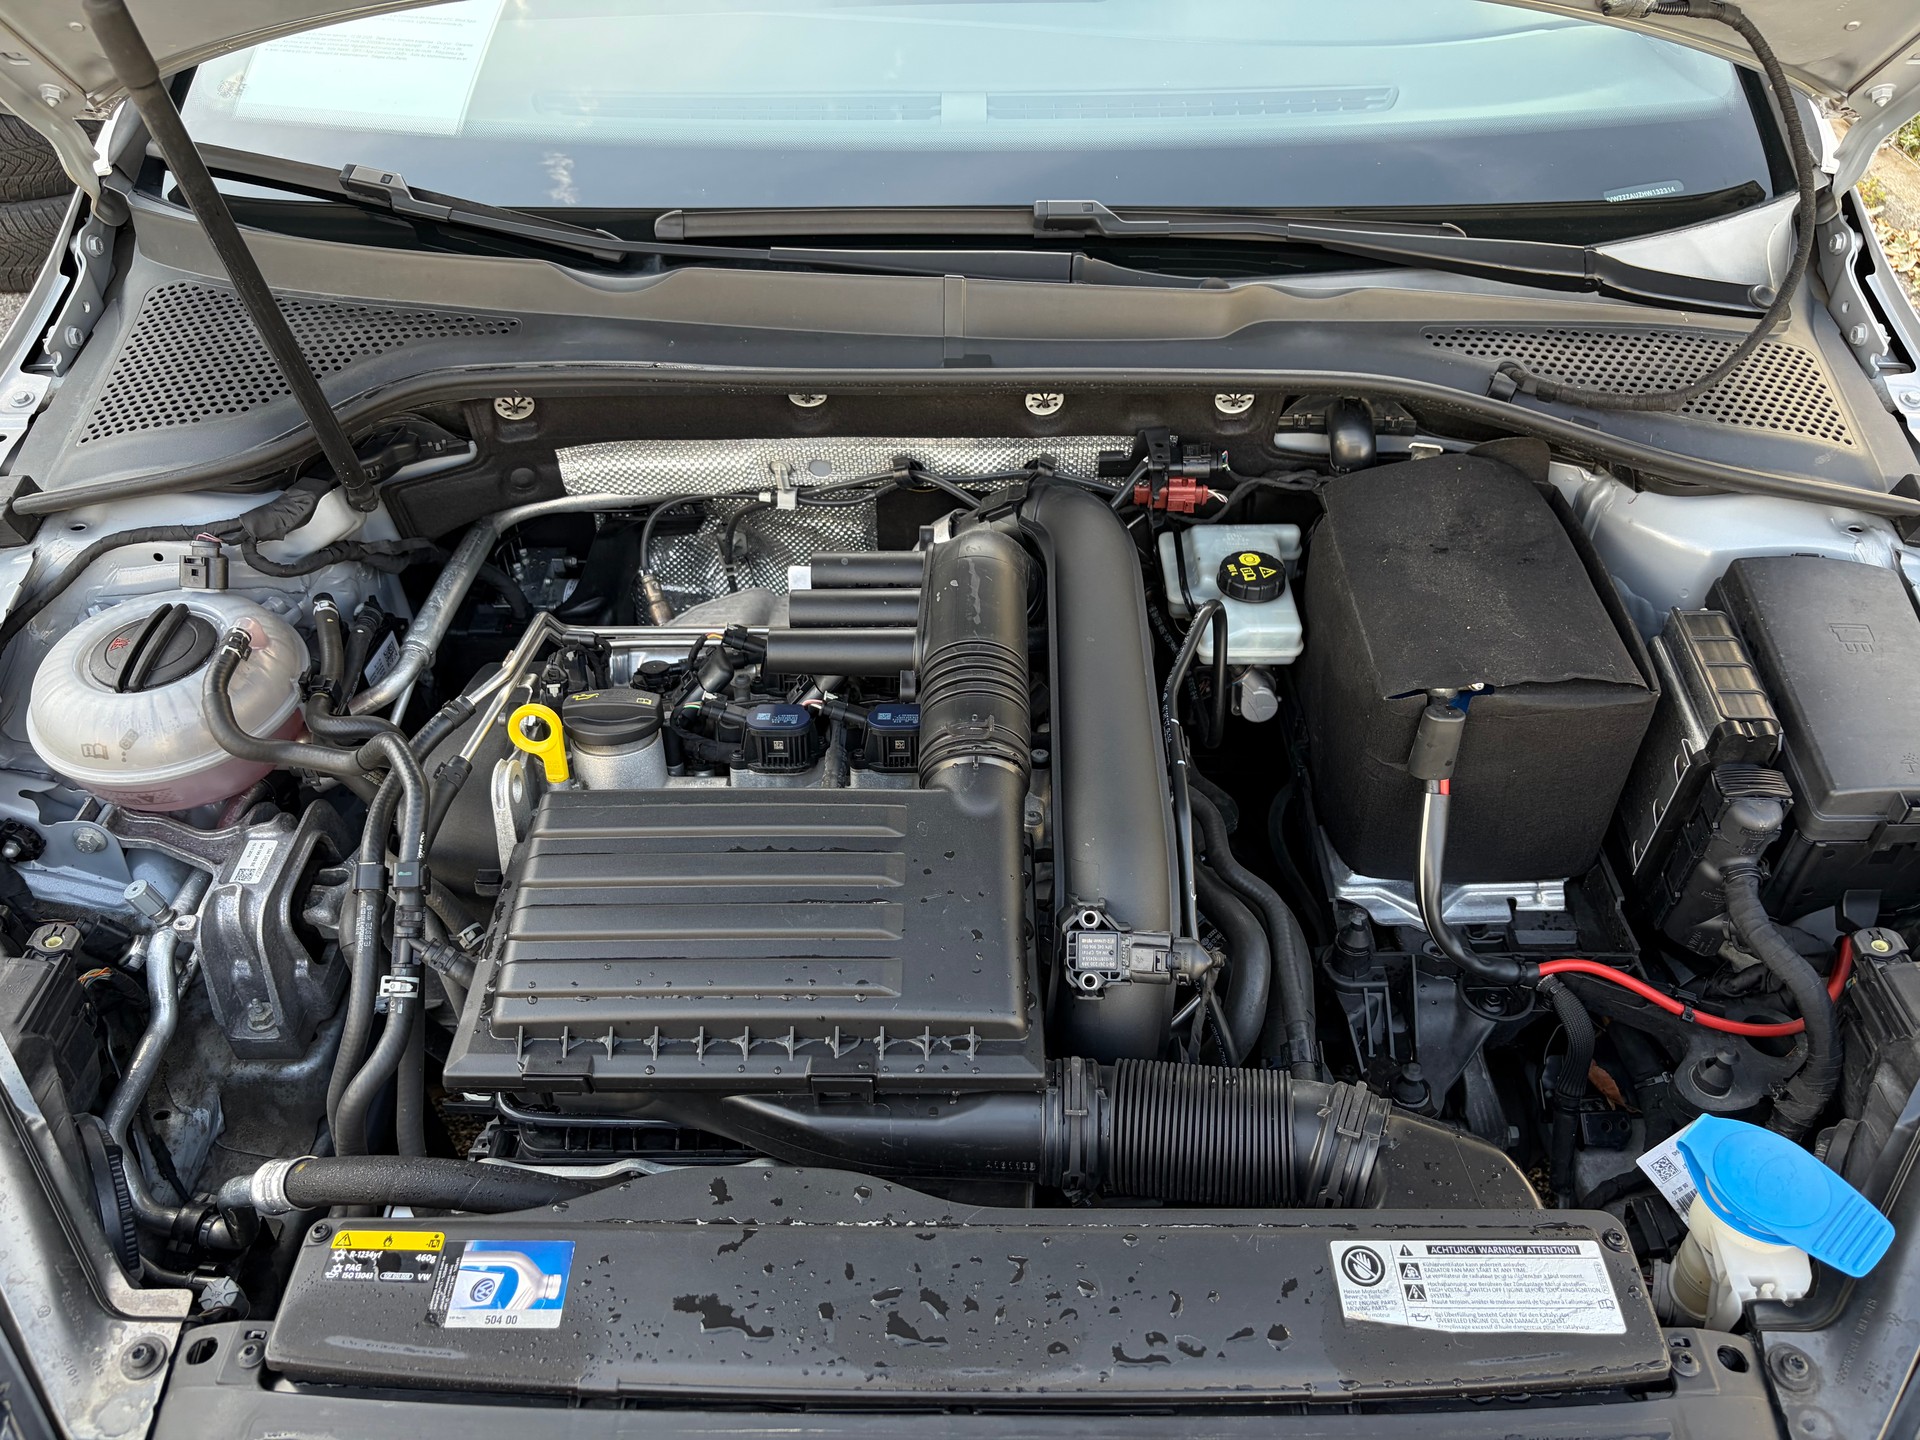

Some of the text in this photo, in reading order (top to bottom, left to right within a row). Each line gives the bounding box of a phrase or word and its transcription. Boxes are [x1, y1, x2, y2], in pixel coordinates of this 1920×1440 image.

[349, 1250, 383, 1260] R-1234yf
[1431, 1246, 1577, 1254] ACHTUNG! WARNING! ATTENTION!
[415, 1254, 436, 1264] 460g
[344, 1264, 362, 1272] PAG
[484, 1315, 518, 1325] 504 00
